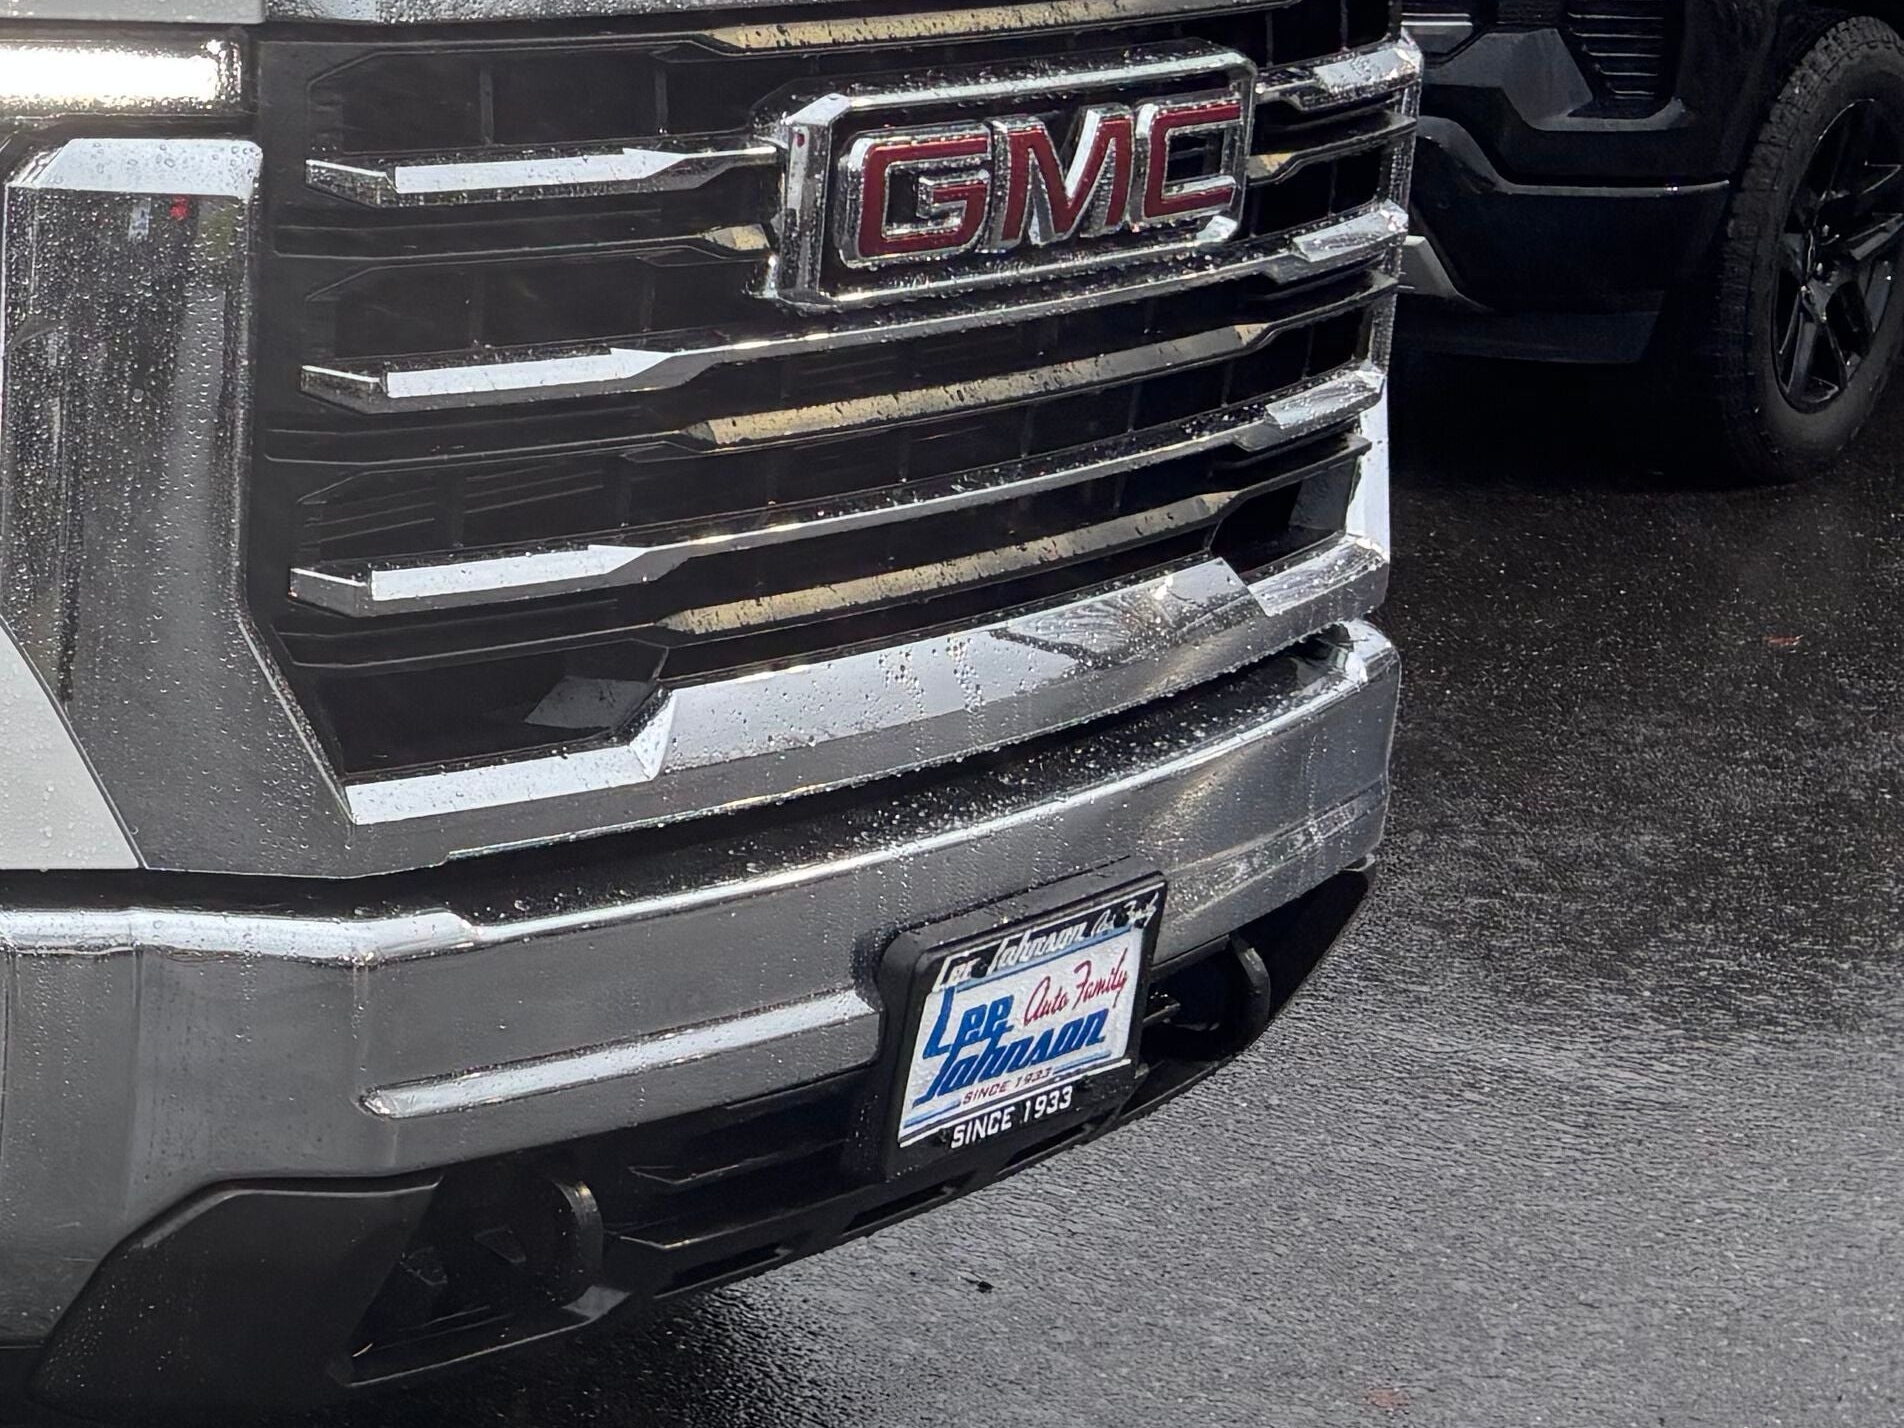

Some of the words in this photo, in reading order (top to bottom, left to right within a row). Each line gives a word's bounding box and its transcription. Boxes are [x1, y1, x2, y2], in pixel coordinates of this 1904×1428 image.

[842, 98, 1244, 268] GMC
[987, 922, 1087, 975] Johnson
[923, 986, 1015, 1059] Lee
[1024, 975, 1069, 1026] Auto
[1072, 947, 1128, 1010] Family
[912, 1008, 1109, 1108] Johnson
[962, 1080, 1009, 1105] SINCE
[1014, 1067, 1052, 1088] 1933
[950, 1106, 1015, 1149] SINCE
[1023, 1085, 1073, 1123] 1933
